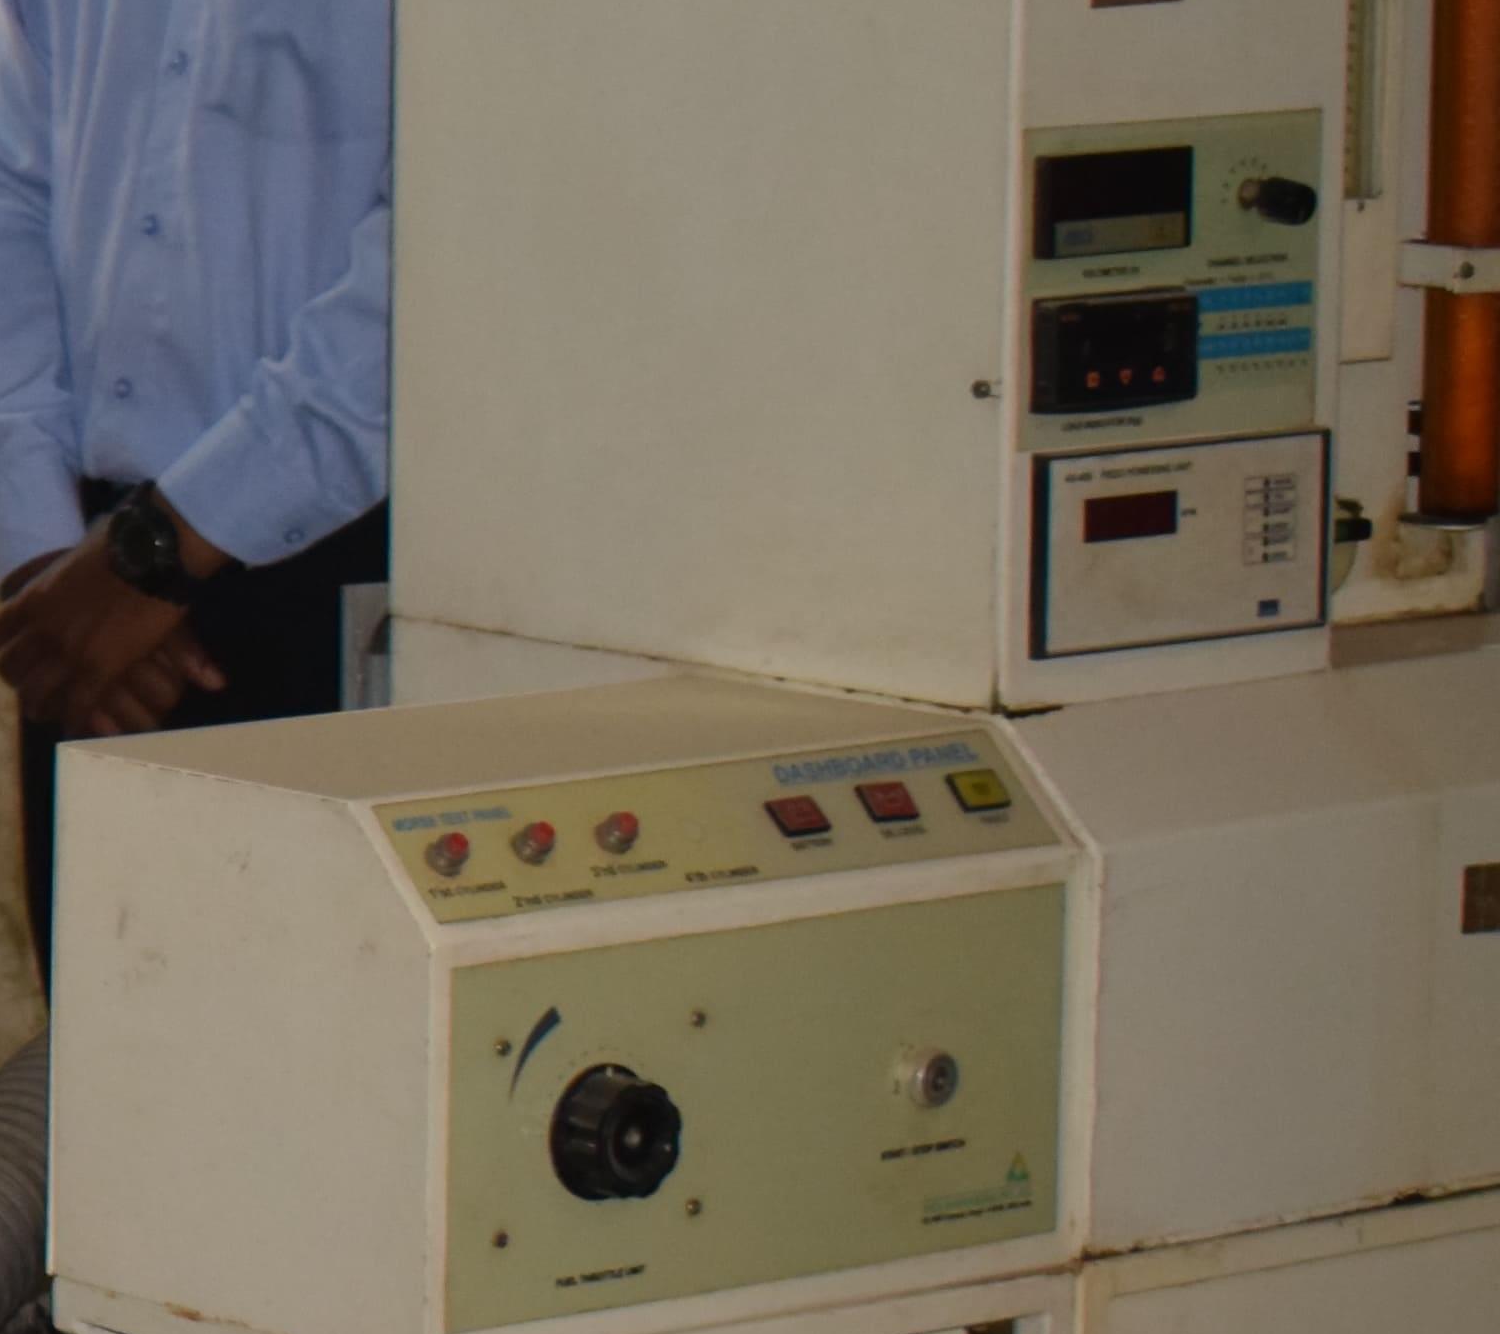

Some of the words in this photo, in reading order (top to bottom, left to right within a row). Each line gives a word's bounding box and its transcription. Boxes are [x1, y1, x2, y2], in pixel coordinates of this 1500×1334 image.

[773, 750, 908, 785] DASHBOARD
[909, 741, 980, 769] PANEL
[439, 811, 468, 825] TEST
[471, 805, 511, 820] PANEL
